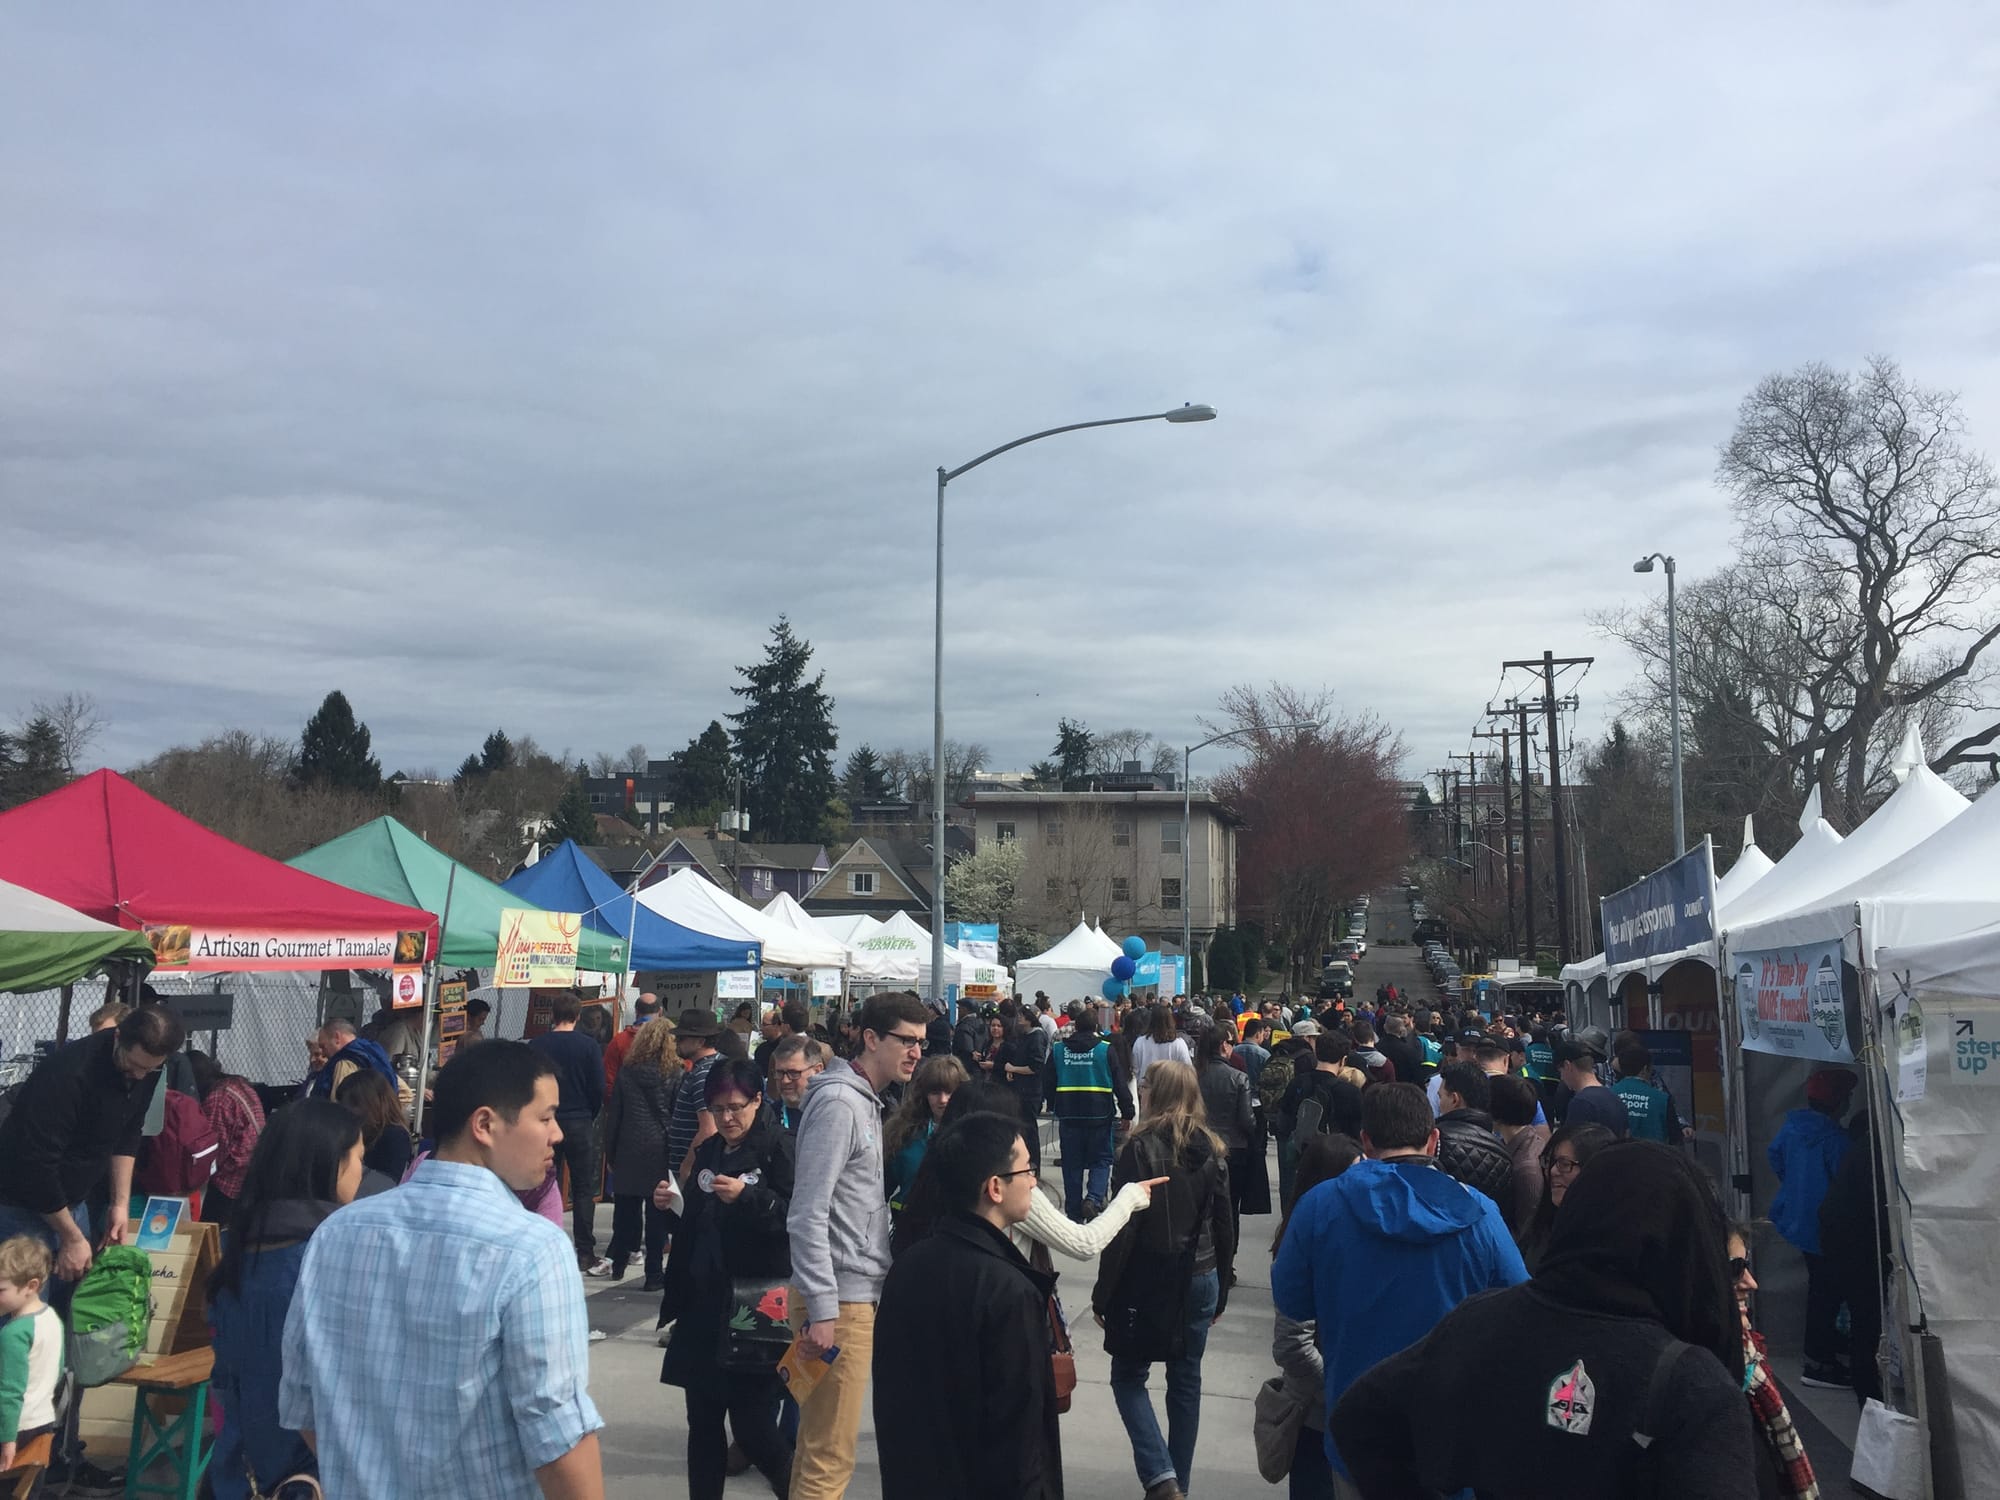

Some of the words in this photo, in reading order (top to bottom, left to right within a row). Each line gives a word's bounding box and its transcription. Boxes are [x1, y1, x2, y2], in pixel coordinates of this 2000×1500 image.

[196, 933, 260, 958] Artisan
[265, 937, 332, 958] Gourmet
[336, 937, 391, 957] Tamales
[656, 982, 702, 991] Peppers
[1758, 989, 1779, 1021] MORE
[1063, 1051, 1094, 1060] Support
[1958, 1057, 1987, 1075] up
[1618, 1092, 1649, 1102] stomer
[1627, 1100, 1648, 1109] port
[150, 1265, 178, 1279] ucha
